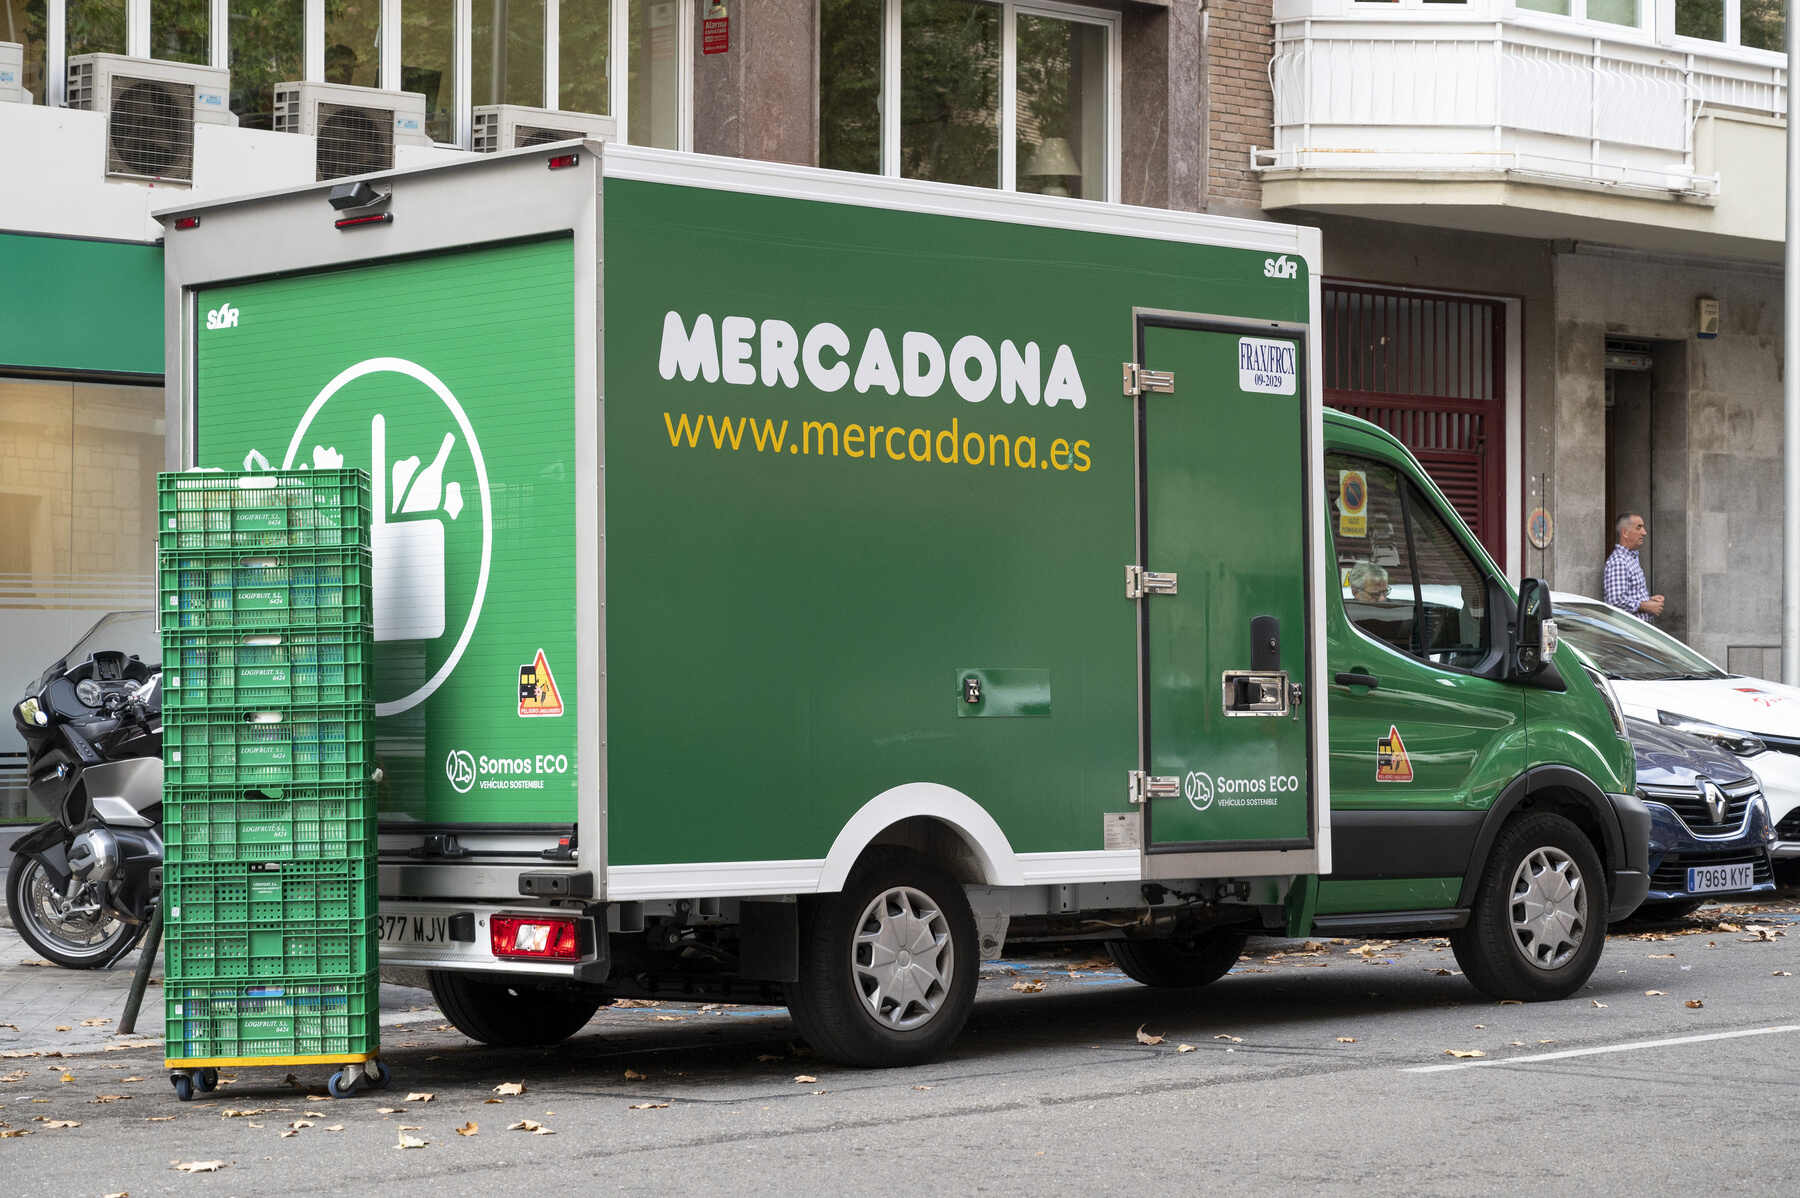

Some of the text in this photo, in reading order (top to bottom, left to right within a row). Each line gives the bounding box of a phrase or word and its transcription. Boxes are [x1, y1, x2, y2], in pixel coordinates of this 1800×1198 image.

[658, 310, 1087, 409] MERCADONA
[1240, 342, 1295, 375] FRAX/FRCX
[1255, 374, 1282, 388] 09-2029
[663, 411, 1091, 472] www.mercadona.es
[479, 754, 568, 774] Somos ECO
[479, 778, 544, 789] VEHÍCULO SOSTENIBLE
[1217, 775, 1299, 793] Somos ECO
[1217, 797, 1278, 807] VEHÍCULO SOSTENIBLE
[1696, 866, 1751, 889] 7969 KYF
[413, 916, 446, 942] MJV
